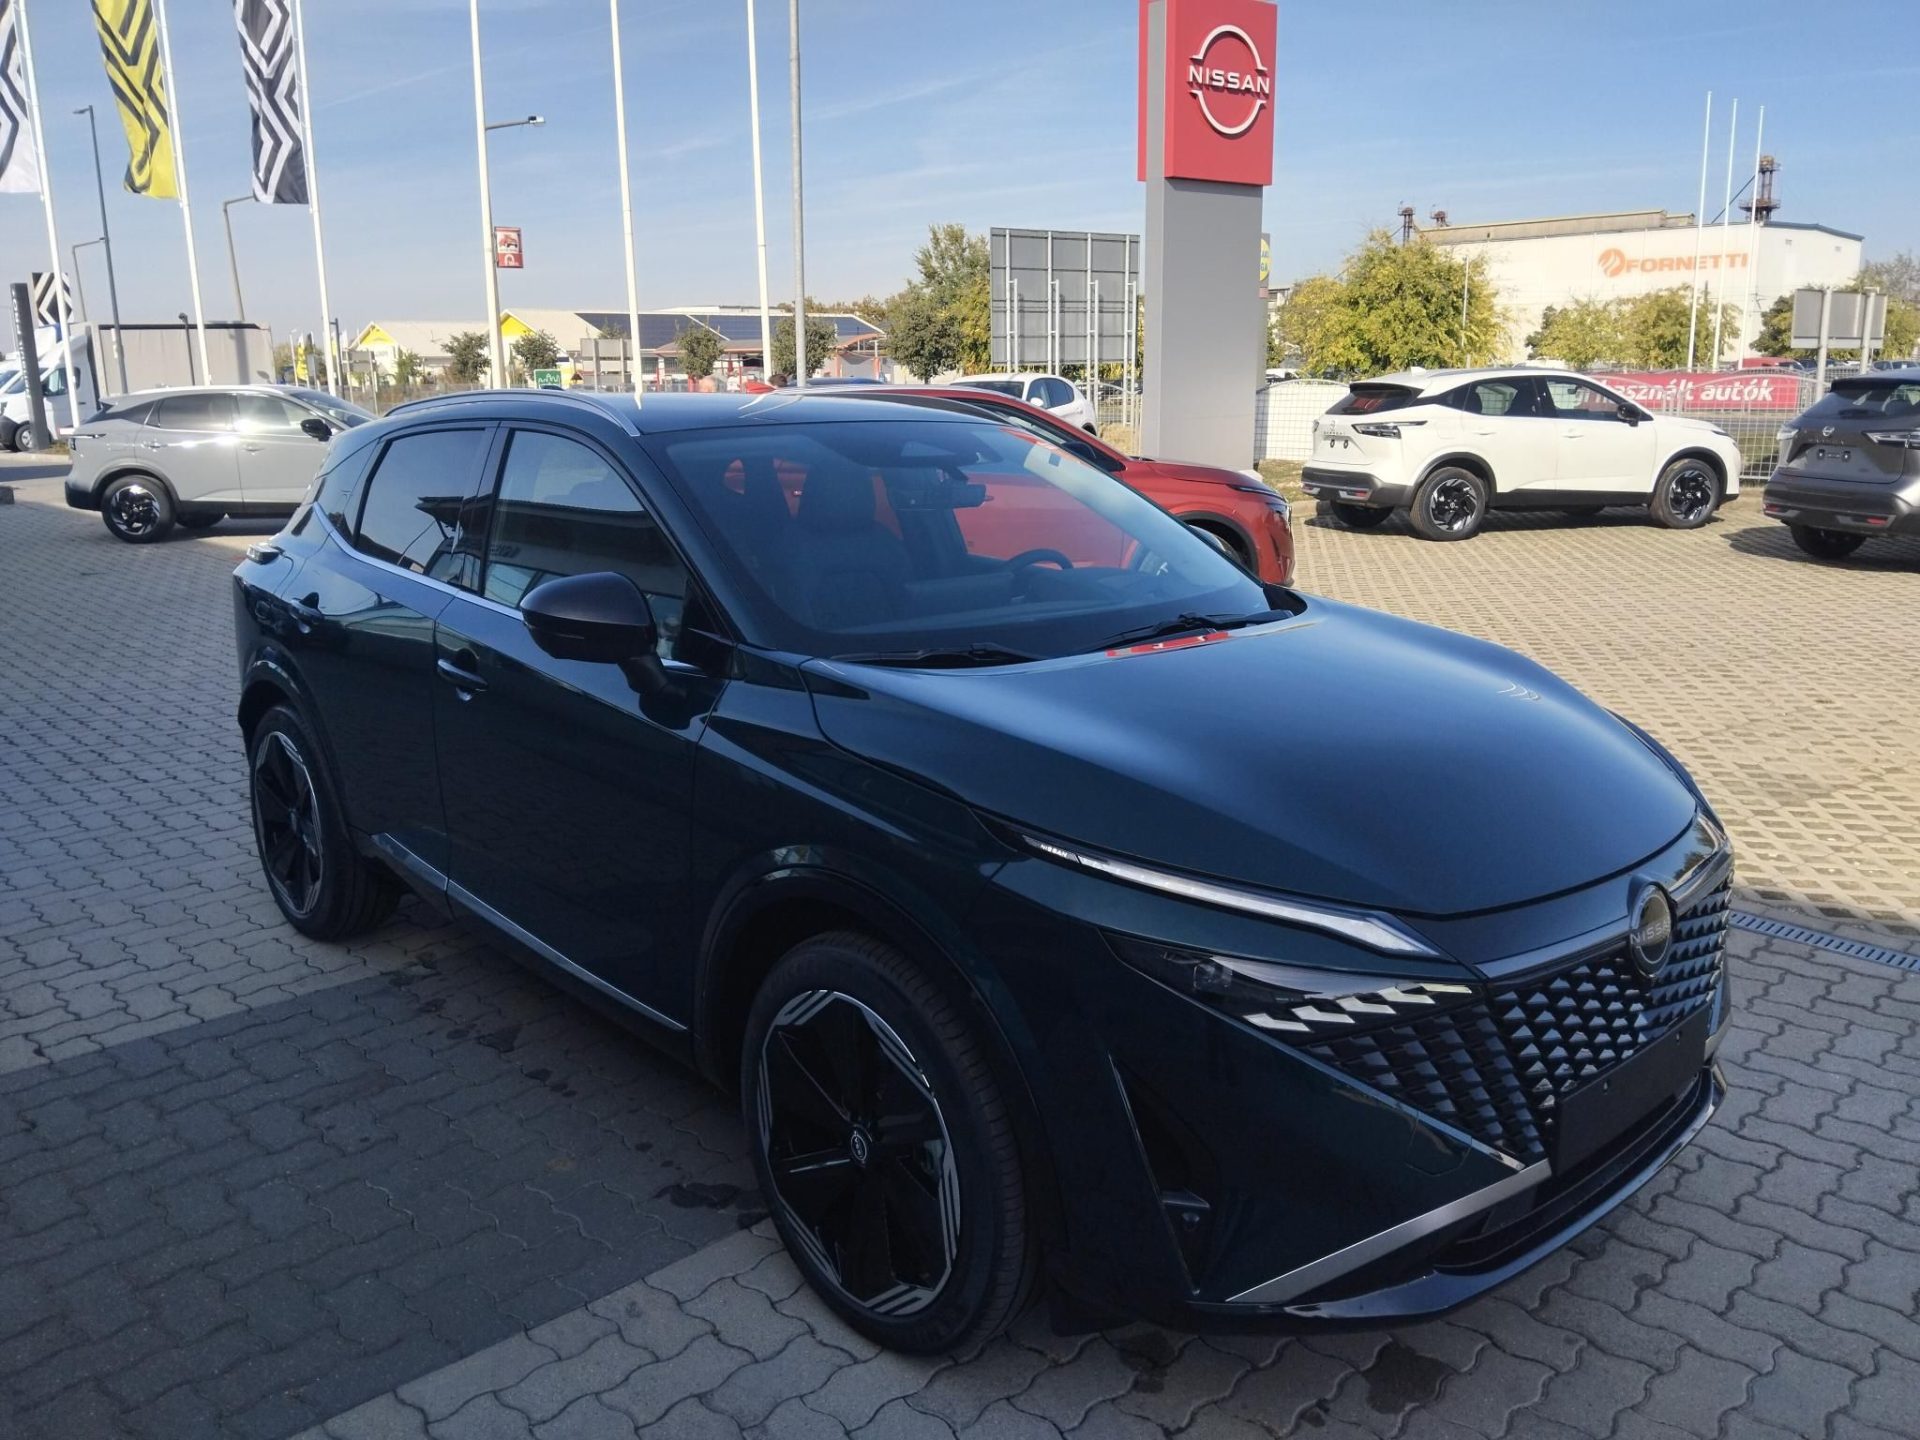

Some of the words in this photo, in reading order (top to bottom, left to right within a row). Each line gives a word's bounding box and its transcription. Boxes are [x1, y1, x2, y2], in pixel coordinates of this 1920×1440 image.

[1189, 65, 1270, 93] NISSAN
[1627, 253, 1748, 273] FORNETTI
[1701, 379, 1774, 401] autók
